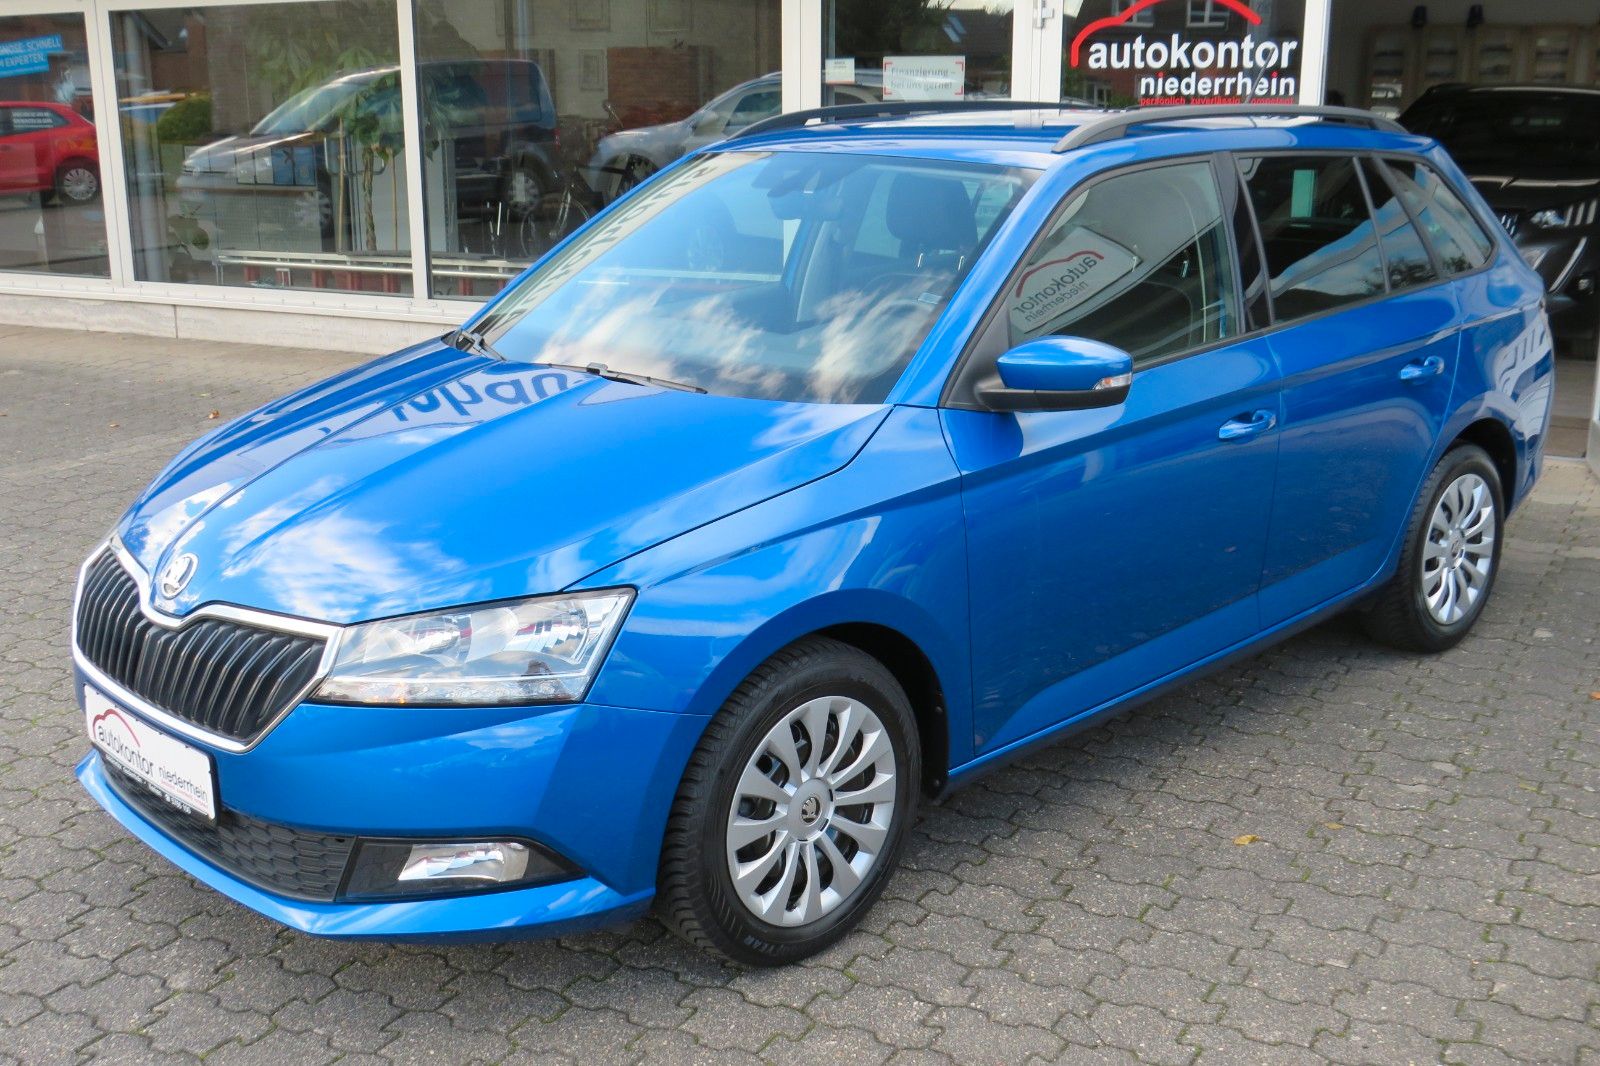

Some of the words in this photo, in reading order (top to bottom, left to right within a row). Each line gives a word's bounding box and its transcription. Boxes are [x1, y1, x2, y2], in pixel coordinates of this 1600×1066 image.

[1088, 32, 1298, 69] autokontor
[1140, 71, 1296, 97] niederrhein
[1248, 96, 1295, 105] ompetent
[97, 725, 155, 778] autokontor
[158, 766, 209, 803] niederrhein
